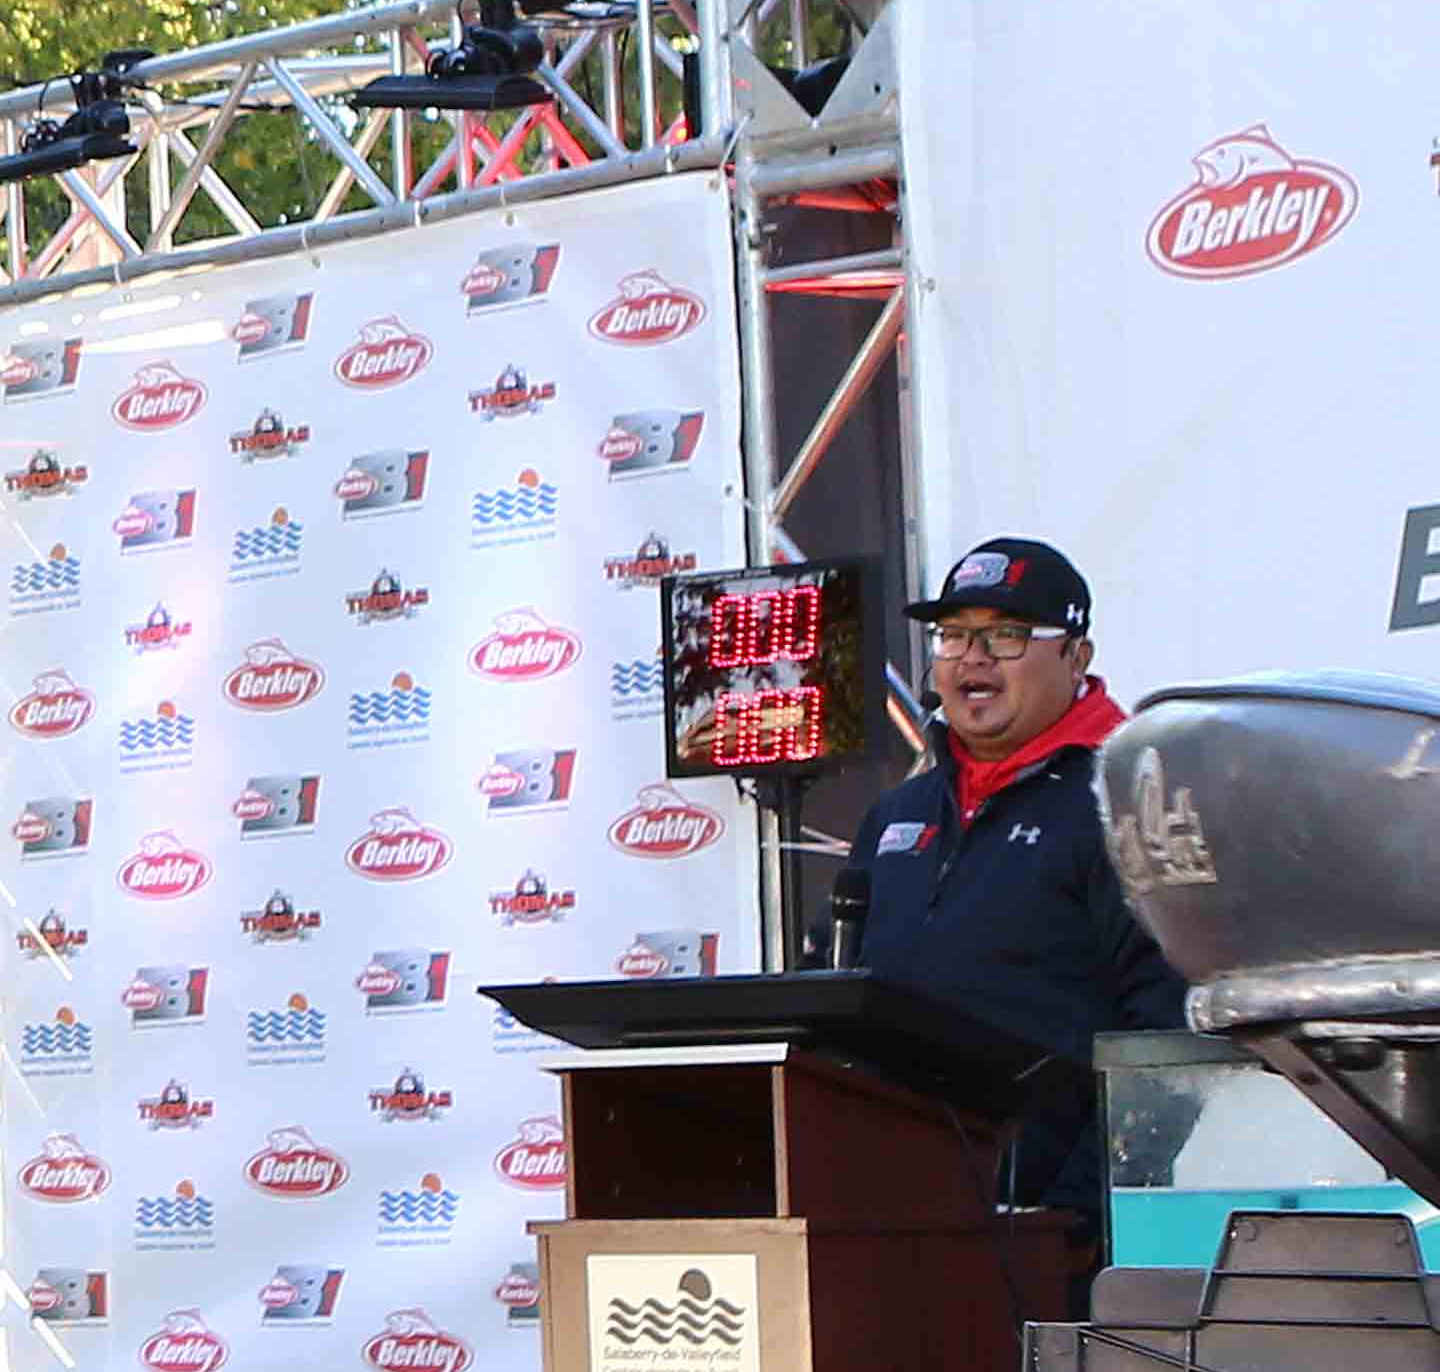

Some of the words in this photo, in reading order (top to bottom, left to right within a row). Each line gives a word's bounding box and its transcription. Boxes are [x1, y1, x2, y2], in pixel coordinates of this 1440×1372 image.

[1170, 182, 1331, 261] Berkley
[606, 299, 693, 335] Berkley
[350, 342, 422, 381] Berkley
[127, 384, 196, 425] Berkley
[484, 639, 566, 671] Berkley
[238, 666, 312, 703] Berkley
[625, 813, 709, 850] Berkley
[360, 837, 440, 870] Berkley
[129, 858, 201, 889] Berkley
[258, 1156, 336, 1192] Berkley
[509, 1148, 565, 1176] Berkl
[30, 1165, 99, 1196] Berkley
[149, 1340, 218, 1372] Berkley
